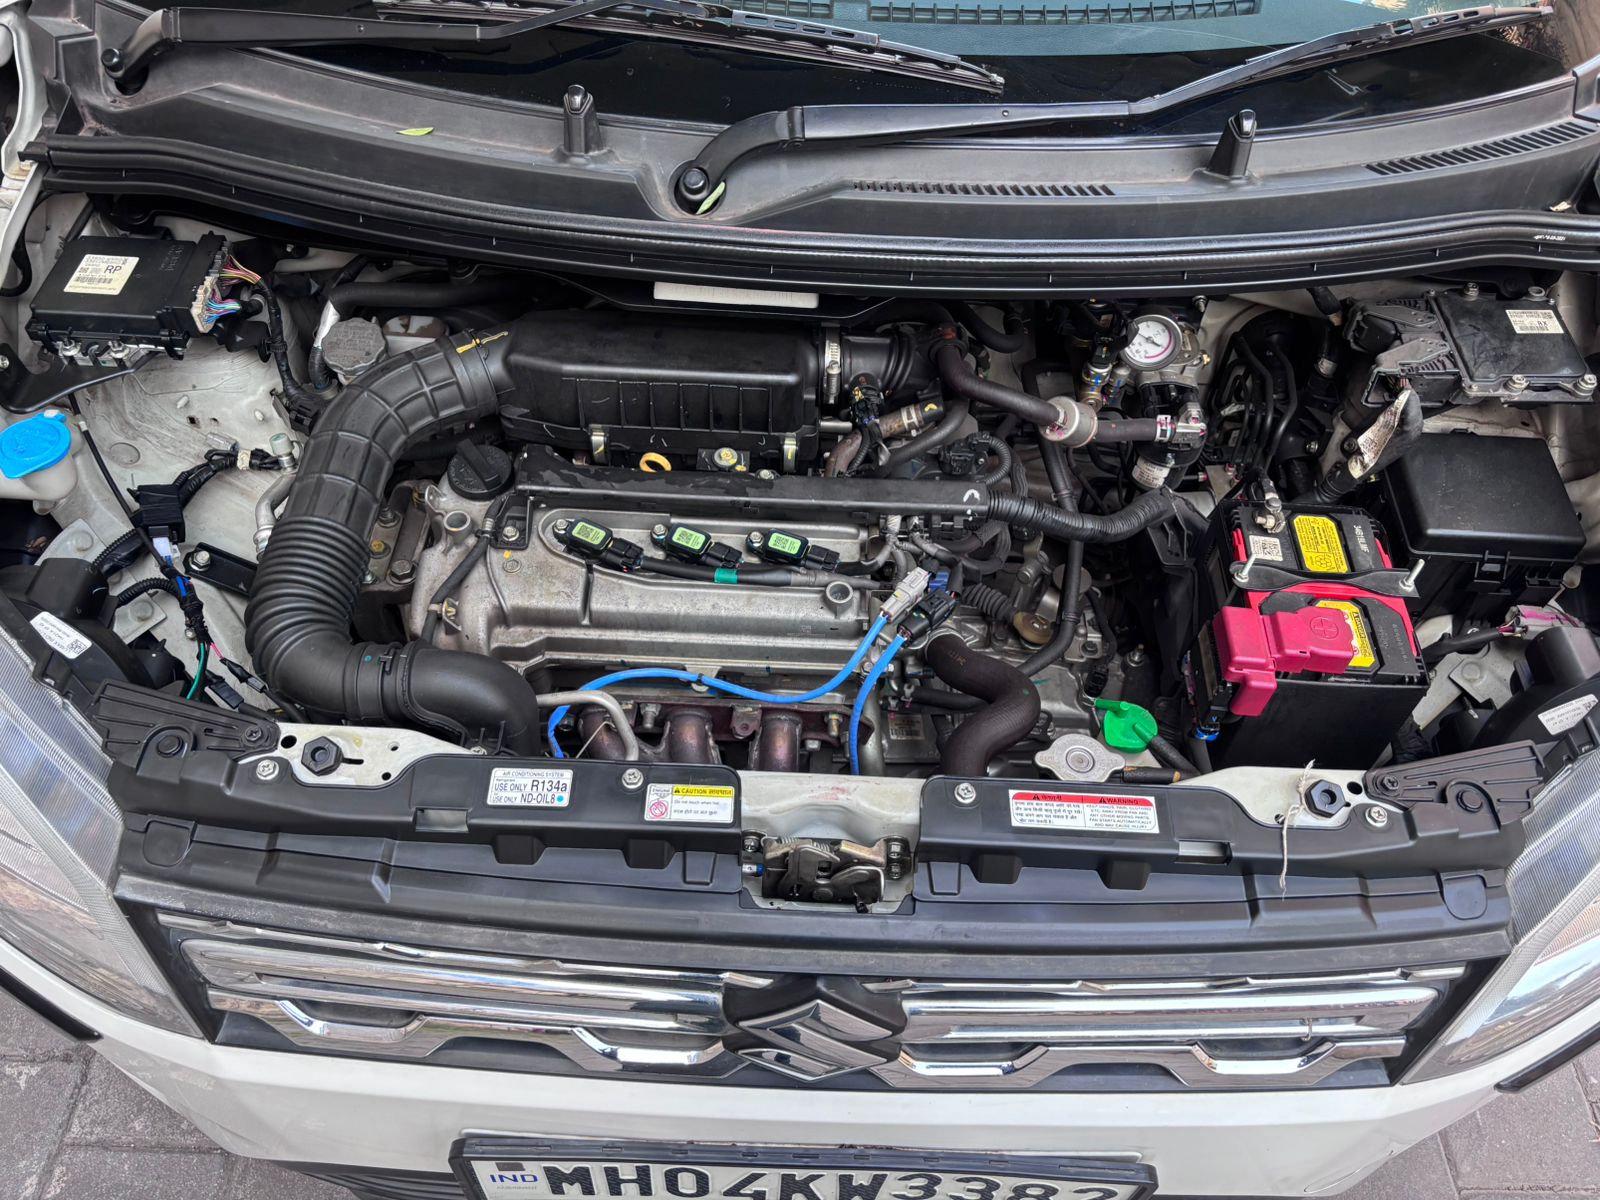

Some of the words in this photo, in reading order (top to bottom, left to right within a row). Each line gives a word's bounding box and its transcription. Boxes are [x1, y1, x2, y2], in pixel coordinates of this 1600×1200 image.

[104, 265, 122, 274] RP
[494, 783, 508, 791] USE
[510, 783, 528, 791] ONLY
[530, 780, 568, 792] R134a
[490, 1174, 538, 1182] IND
